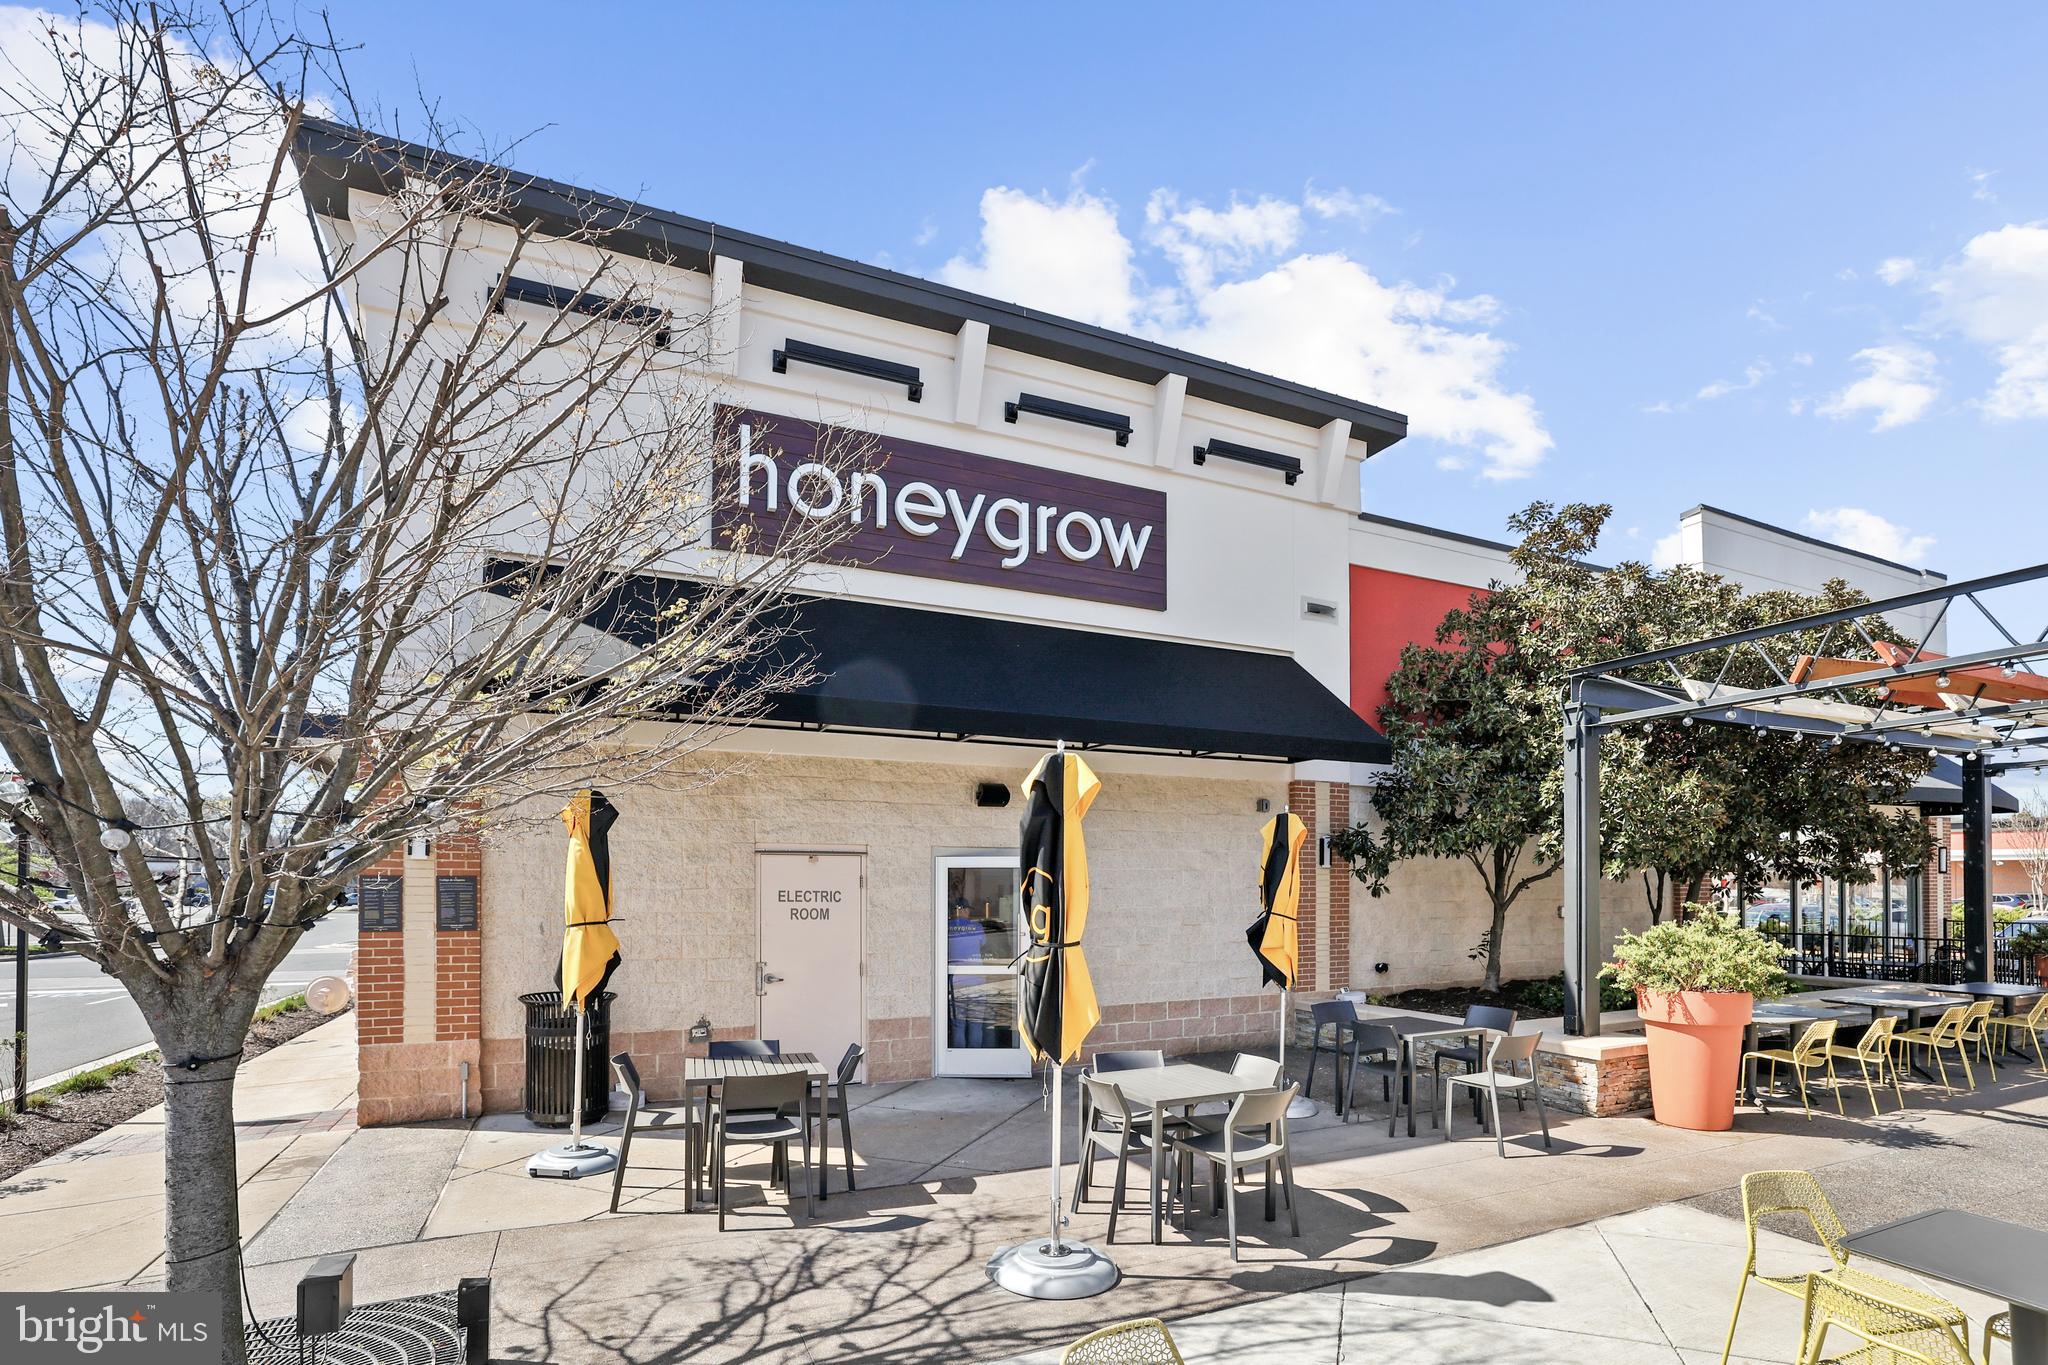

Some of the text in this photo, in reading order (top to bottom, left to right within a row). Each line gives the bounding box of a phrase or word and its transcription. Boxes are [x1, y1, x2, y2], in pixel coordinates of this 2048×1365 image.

[739, 424, 1153, 571] honeygrow
[778, 890, 842, 903] ELECTRIC
[790, 908, 830, 920] ROOM
